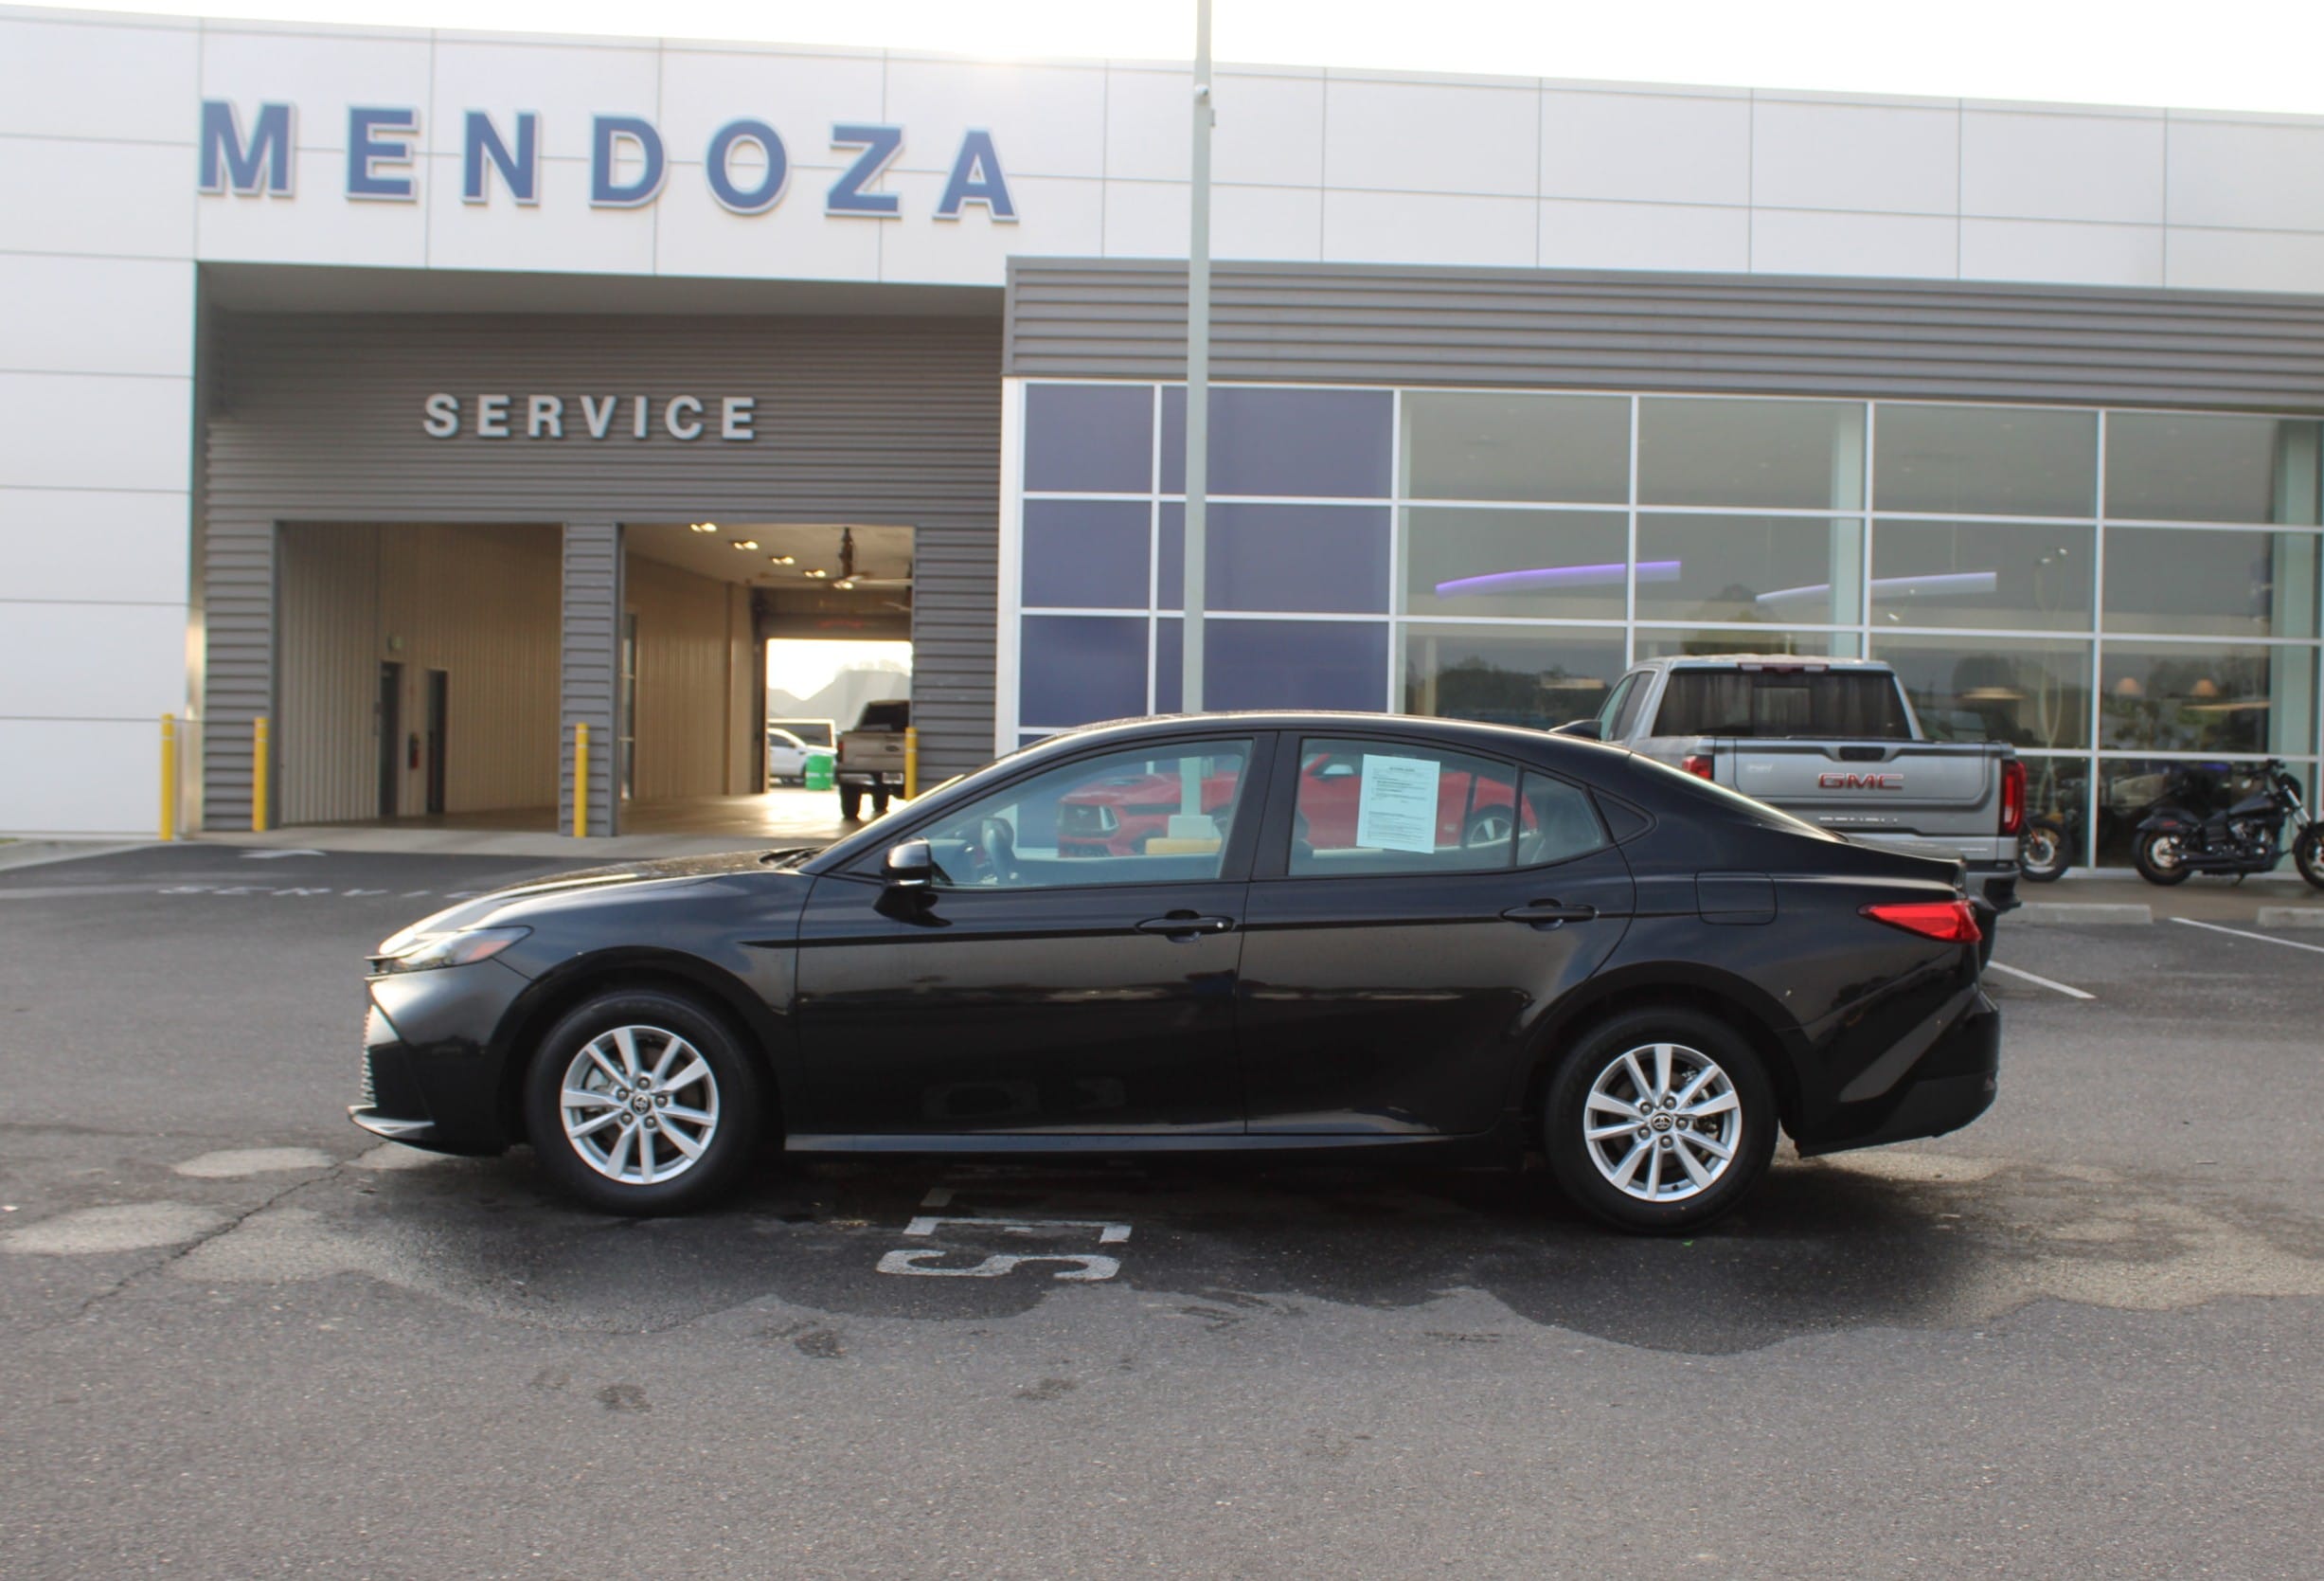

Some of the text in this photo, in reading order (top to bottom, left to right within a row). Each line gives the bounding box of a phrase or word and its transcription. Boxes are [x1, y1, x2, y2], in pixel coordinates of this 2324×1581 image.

[198, 99, 1020, 223] MENDOZA
[422, 392, 756, 440] SERVICE
[1817, 772, 1904, 790] GMC
